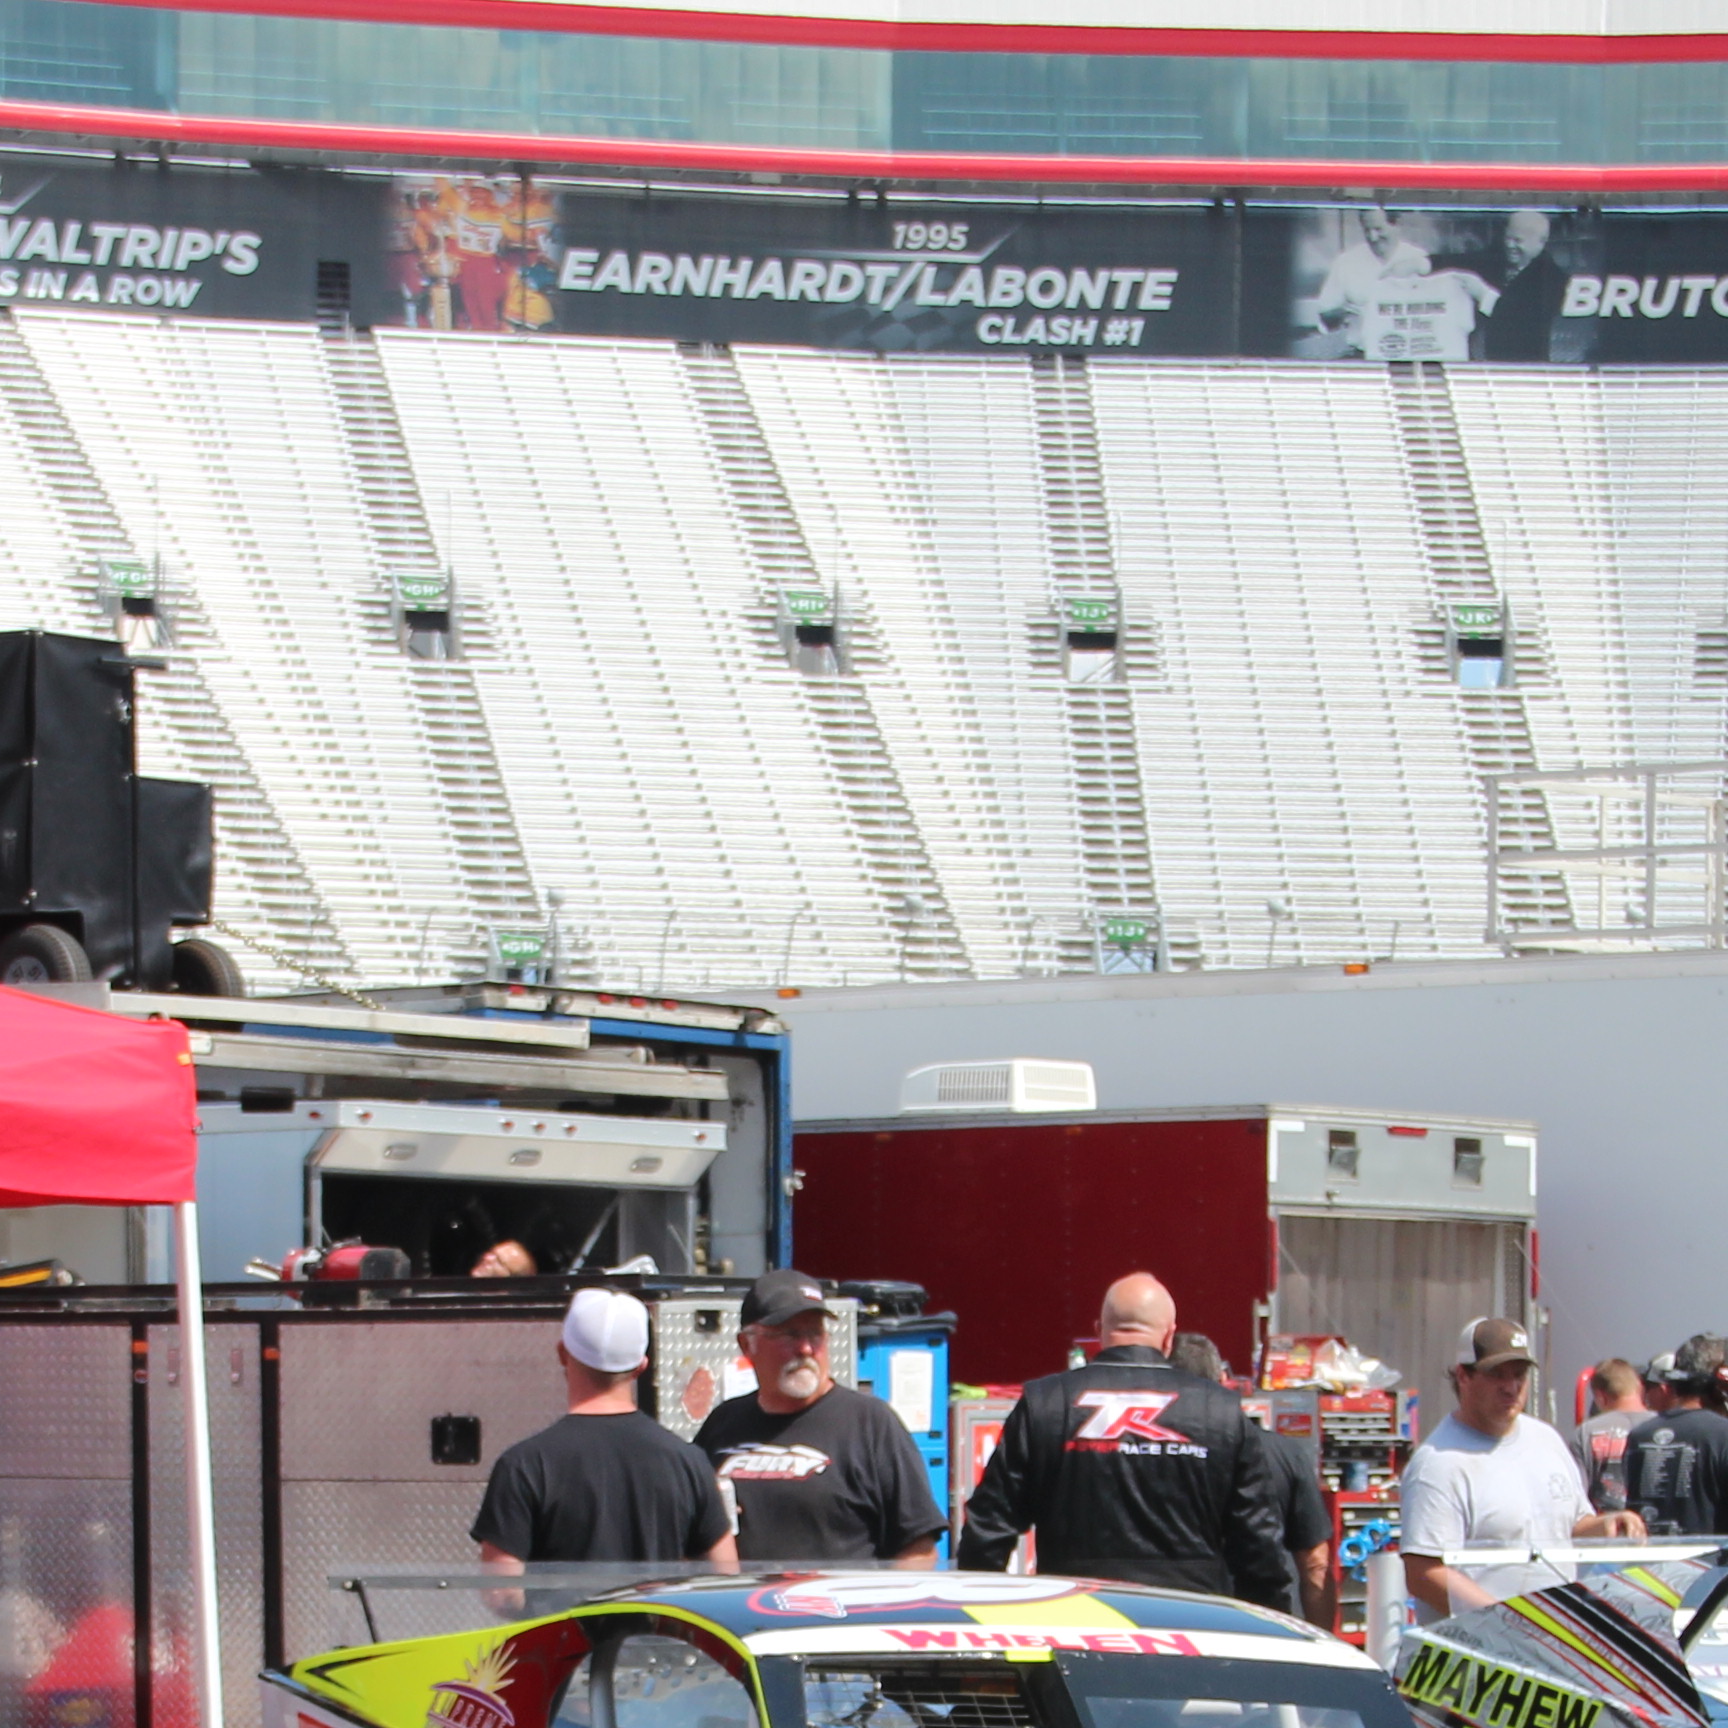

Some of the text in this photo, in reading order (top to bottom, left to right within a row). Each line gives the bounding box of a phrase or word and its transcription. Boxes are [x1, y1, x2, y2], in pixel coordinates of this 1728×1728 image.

[893, 221, 969, 251] 1995
[26, 270, 68, 300] IN
[72, 273, 101, 303] A
[109, 275, 204, 308] ROW
[559, 249, 1178, 312] EARNHARDT/LABONTE
[978, 315, 1145, 346] CLASH #1
[718, 1453, 827, 1477] FURY
[1166, 1443, 1208, 1459] CARS
[878, 1628, 1205, 1657] WHELEN
